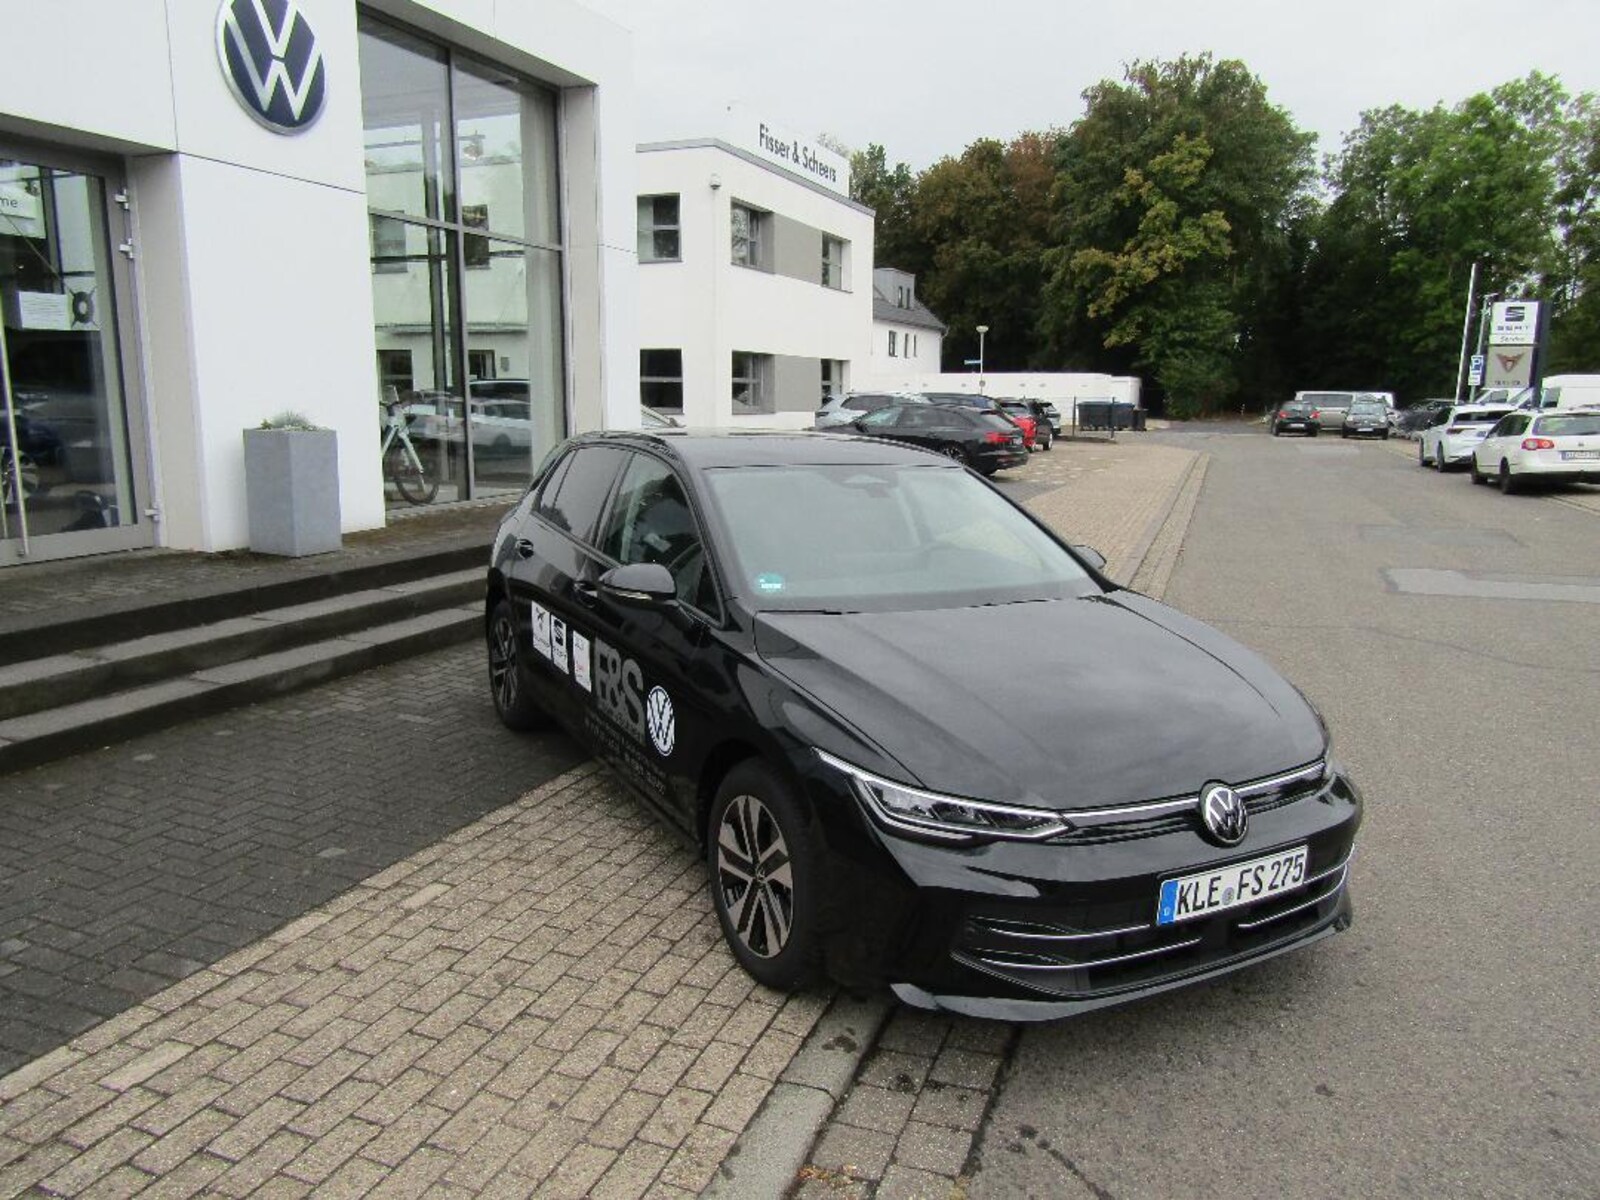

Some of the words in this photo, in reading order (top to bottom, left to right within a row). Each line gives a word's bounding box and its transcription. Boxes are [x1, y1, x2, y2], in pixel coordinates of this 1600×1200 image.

[759, 122, 790, 159] Fisser
[792, 140, 800, 164] &
[802, 146, 836, 182] Scheers
[1177, 876, 1221, 915] KLE
[1237, 865, 1265, 900] FS
[1268, 853, 1305, 891] 275
